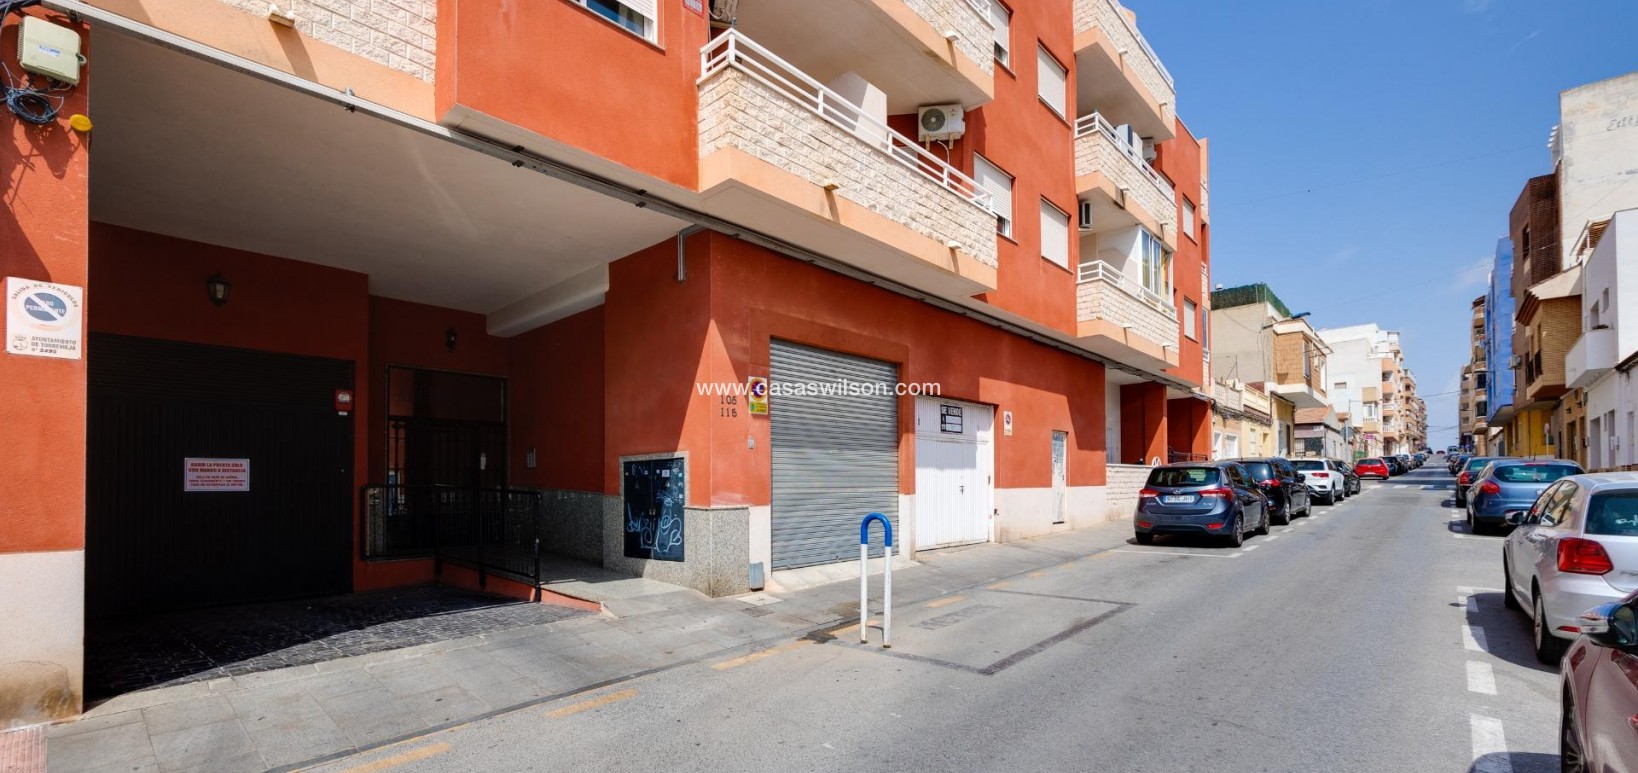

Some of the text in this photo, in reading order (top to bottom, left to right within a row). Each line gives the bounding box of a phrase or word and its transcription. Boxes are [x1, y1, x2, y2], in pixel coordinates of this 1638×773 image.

[31, 336, 77, 345] AYUNTAMIENTO
[41, 342, 76, 350] TORREVIEJA
[948, 407, 962, 416] VENDE
